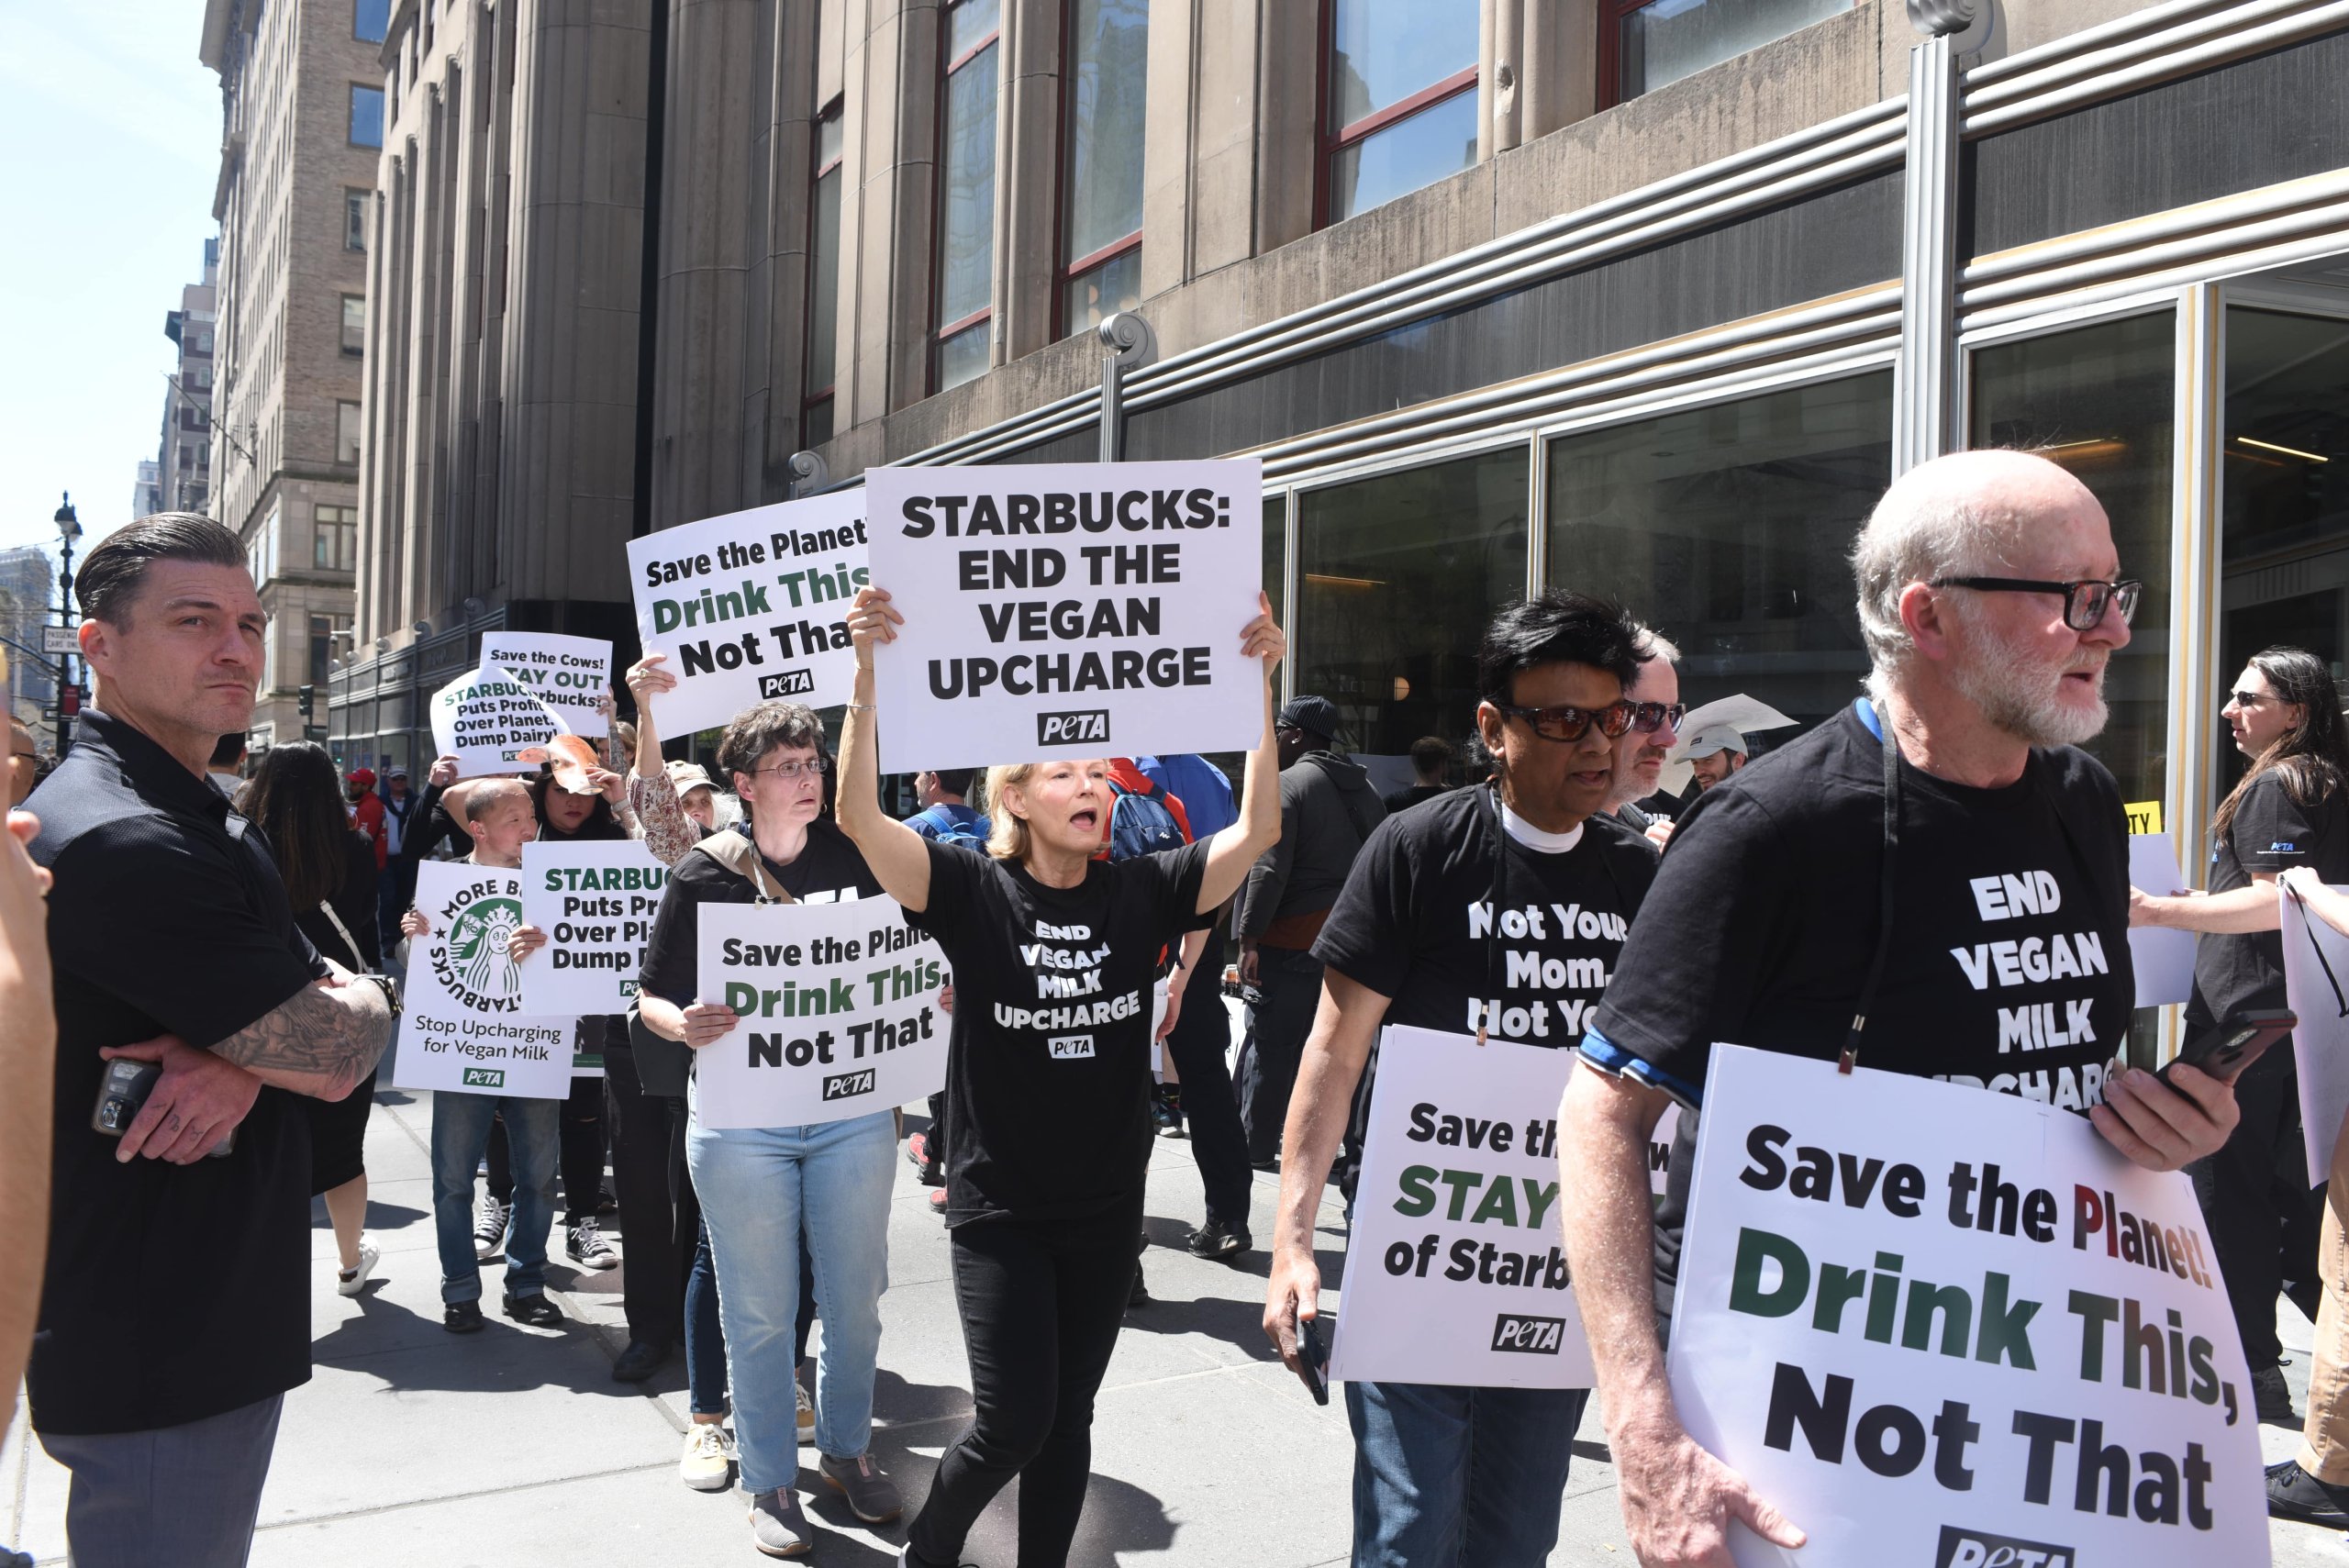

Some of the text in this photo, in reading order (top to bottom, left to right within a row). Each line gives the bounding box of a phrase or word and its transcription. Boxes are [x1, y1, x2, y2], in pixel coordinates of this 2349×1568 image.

[901, 488, 1230, 539] STARBUCKS:
[646, 517, 868, 588] Save the Planet
[959, 543, 1181, 591] END THE
[652, 579, 773, 635] Drink
[978, 596, 1161, 643] VEGAN
[490, 649, 605, 670] Save the Cows!
[678, 619, 854, 678] Not Tha
[445, 682, 532, 706] STARBUC
[495, 666, 604, 690] TAY OUT
[928, 646, 1211, 700] UPCHARGE
[457, 700, 496, 717] Puts
[532, 689, 602, 708] rbucks!
[453, 713, 554, 733] Over Planet.
[455, 728, 559, 749] Dump Dairy!
[2129, 812, 2151, 835] TY
[440, 879, 499, 921] MORE
[563, 896, 624, 917] Puts
[1969, 870, 2062, 922] END
[553, 922, 617, 944] Over
[1035, 919, 1091, 940] END
[1468, 902, 1547, 940] Not
[552, 948, 631, 973] Dump
[722, 938, 802, 967] Save
[810, 936, 862, 965] the
[1019, 941, 1112, 970] VEGAN
[1949, 931, 2110, 990] VEGAN
[430, 946, 522, 1013] TARBUCKS
[725, 957, 951, 1018] Drink This,
[1037, 968, 1103, 999] MILK
[415, 1015, 562, 1044] Stop Upcharging
[994, 989, 1141, 1030] UPCHARGE
[1997, 997, 2098, 1054] MILK
[423, 1038, 549, 1062] for Vegan Milk
[748, 1006, 933, 1068] Not That
[1406, 1102, 1515, 1153] Save
[1392, 1164, 1561, 1230] STAY
[1738, 1123, 2214, 1290] Save the Planet!
[1384, 1233, 1573, 1291] of Starb
[1729, 1226, 2240, 1428] Drink This,
[1764, 1361, 2214, 1531] Not That
